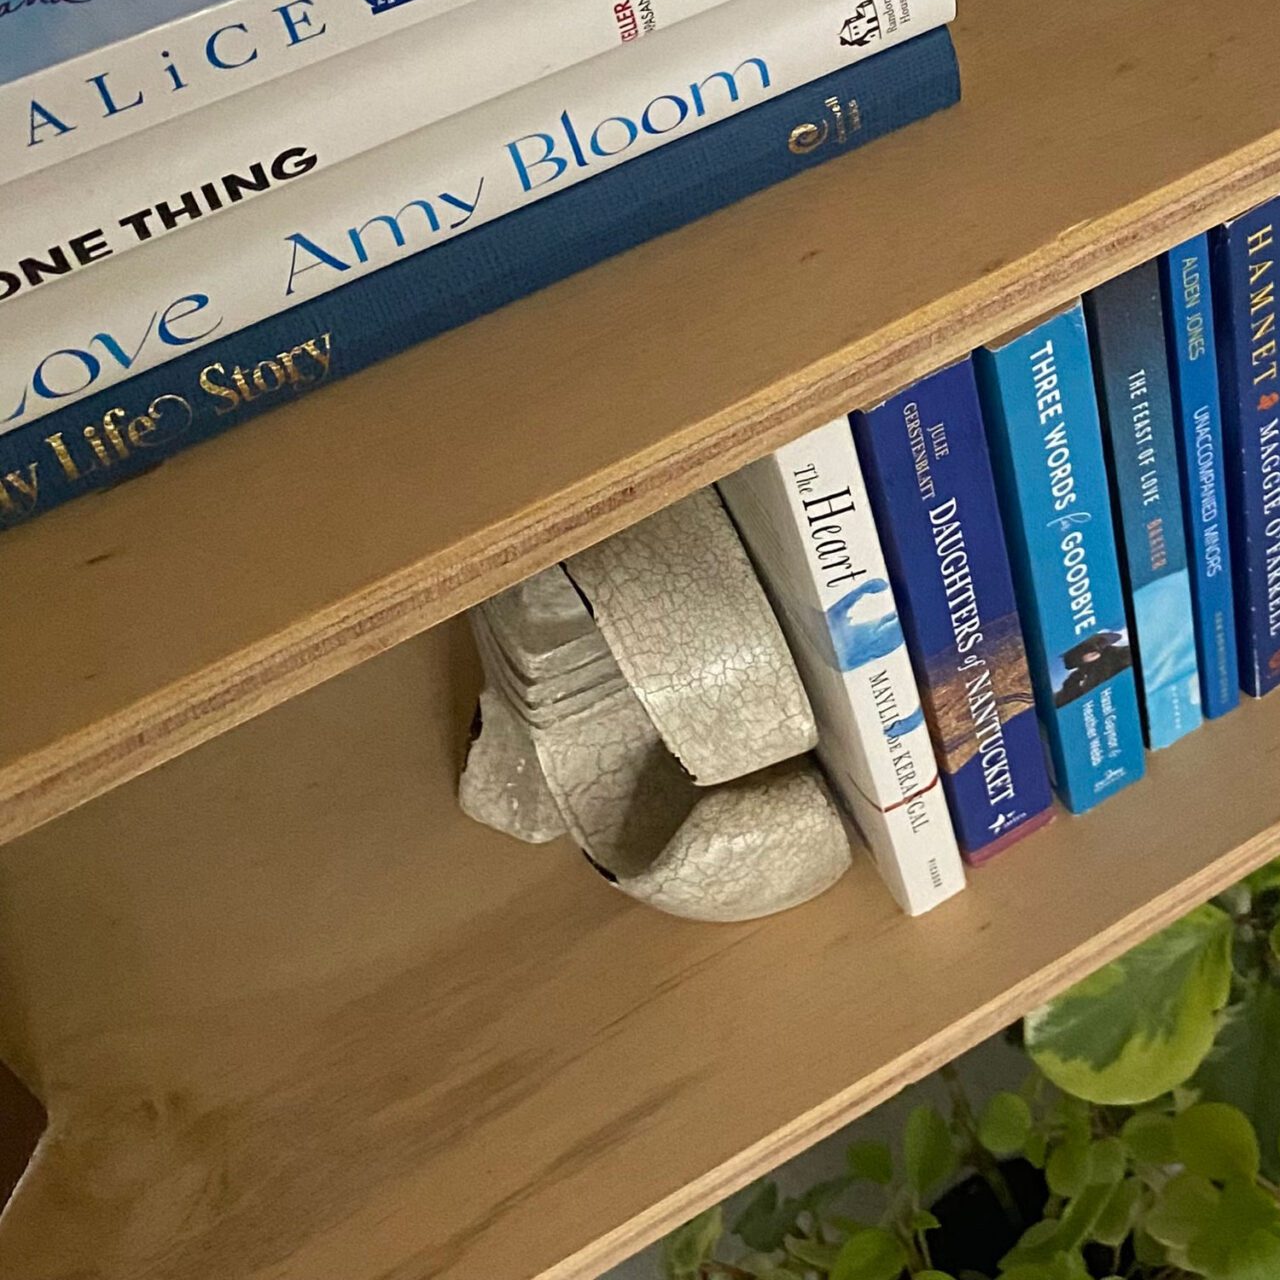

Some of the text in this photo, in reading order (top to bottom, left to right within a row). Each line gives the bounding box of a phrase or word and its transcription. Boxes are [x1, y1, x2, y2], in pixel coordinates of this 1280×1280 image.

[119, 146, 318, 241] THING
[285, 176, 485, 296] Amy
[504, 56, 772, 193] Bloom
[1181, 256, 1206, 362] ALDEN JONES
[1247, 223, 1277, 386] HAMNET
[45, 394, 193, 482] Life
[199, 331, 333, 416] Story
[1029, 339, 1063, 425] THREE
[1128, 369, 1160, 507] THE FEAST OF LOVE
[902, 401, 936, 502] GERSTENBLATT
[926, 423, 949, 461] JULIE
[1043, 421, 1076, 511] WORDS
[1193, 405, 1222, 578] UNACCOMPANIED MINORS
[793, 463, 867, 589] The Heart
[928, 496, 984, 654] DAUGHTERS
[1060, 531, 1096, 636] GOODBYE
[957, 654, 986, 672] of
[965, 669, 1015, 807] NANTUCKET
